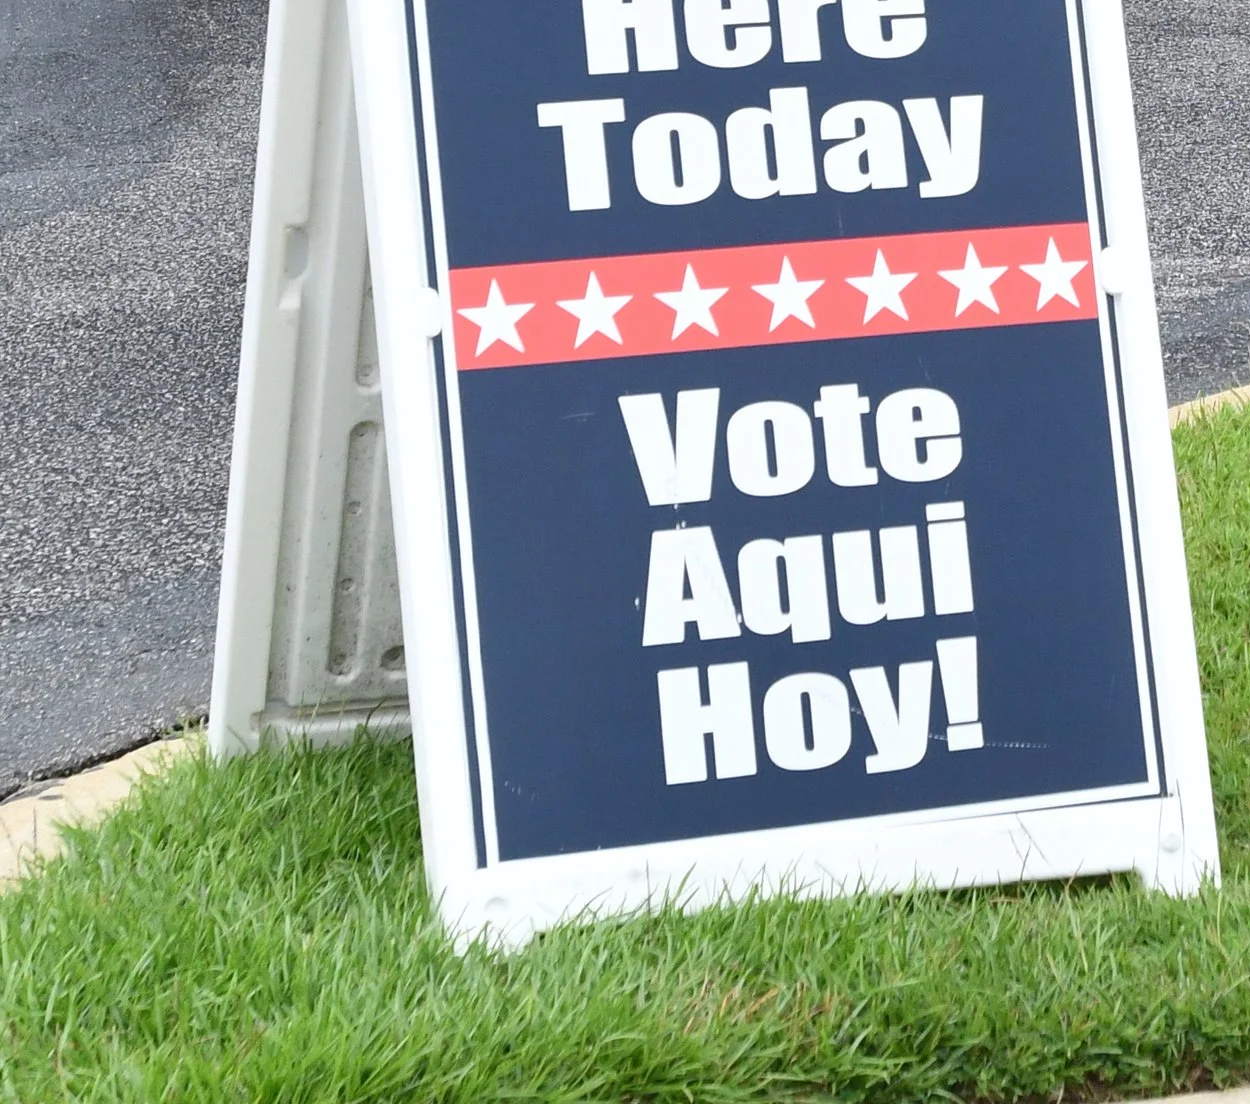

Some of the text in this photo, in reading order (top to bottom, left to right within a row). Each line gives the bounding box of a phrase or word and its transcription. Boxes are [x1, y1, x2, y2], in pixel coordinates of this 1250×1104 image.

[536, 86, 984, 212] Today
[617, 383, 963, 509] Vote
[642, 500, 974, 648] Aqui
[656, 635, 985, 787] Hoy!
